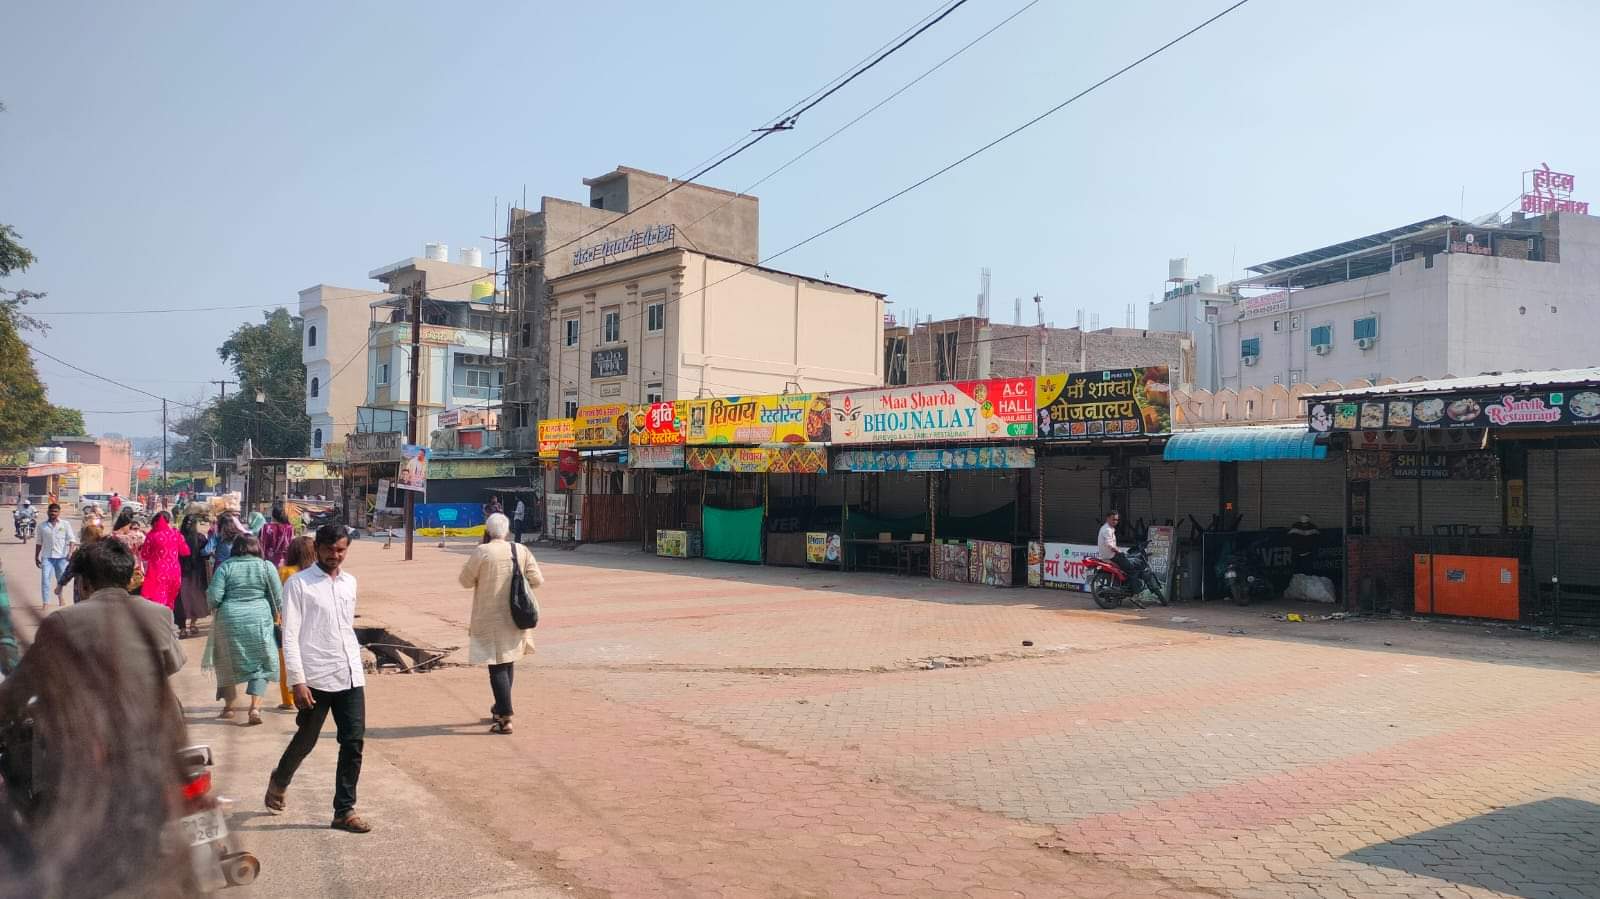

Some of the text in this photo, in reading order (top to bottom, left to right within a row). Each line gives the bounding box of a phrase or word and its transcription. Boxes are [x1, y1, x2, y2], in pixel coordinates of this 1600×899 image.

[1533, 162, 1575, 192] होटल
[1002, 382, 1027, 396] A.C.
[1067, 377, 1133, 399] माँ शारदा
[880, 389, 956, 410] Maa Sharda
[999, 399, 1033, 412] HALL
[1050, 397, 1135, 420] भोजनालय
[1503, 396, 1544, 411] Satvik
[651, 403, 673, 428] श्रुति
[710, 400, 757, 425] शिवाय
[863, 408, 977, 432] BHOJNALAY
[1001, 414, 1033, 422] VAILABLE
[1487, 407, 1560, 424] Restaurant
